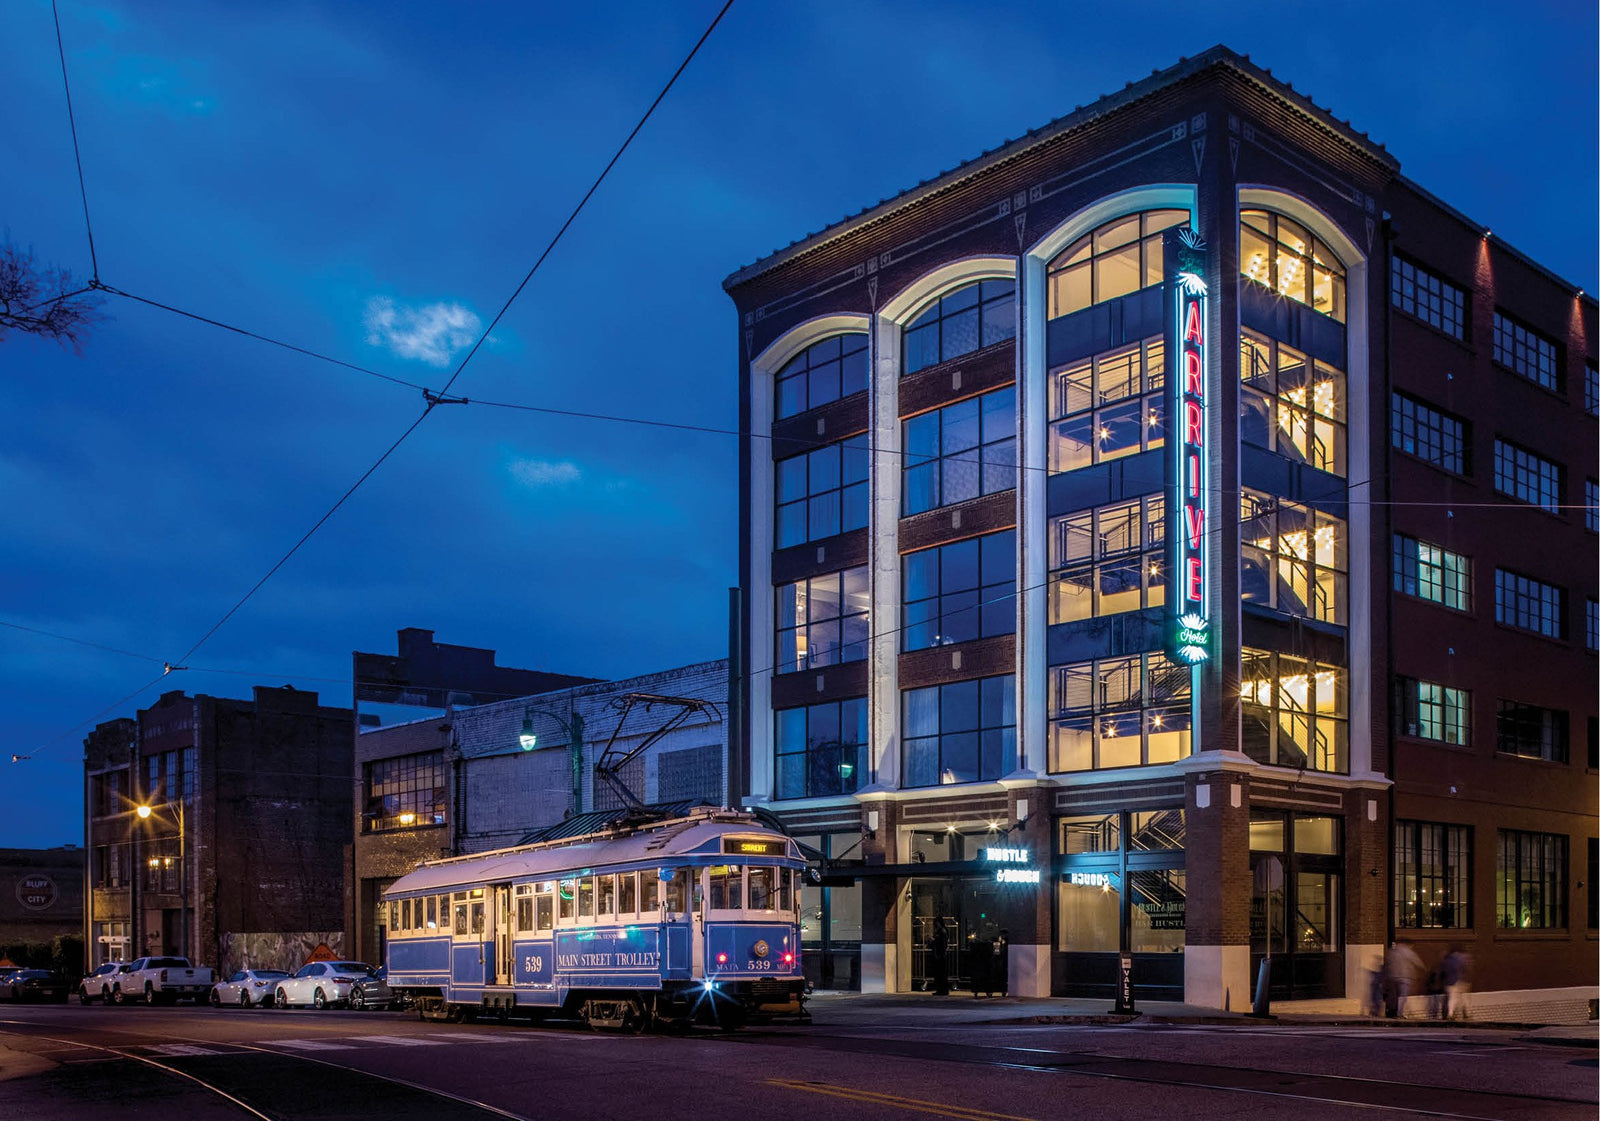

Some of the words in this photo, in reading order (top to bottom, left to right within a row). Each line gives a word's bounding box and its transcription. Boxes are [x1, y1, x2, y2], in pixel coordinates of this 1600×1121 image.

[1184, 301, 1204, 603] ARRIVE
[1180, 628, 1208, 645] Hotel
[986, 847, 1029, 862] HUSTLE
[26, 880, 47, 888] BLUFF
[27, 895, 46, 903] CITY
[525, 955, 542, 973] 539
[558, 954, 579, 967] MAIN
[581, 952, 612, 966] STREET
[614, 951, 656, 966] TROLLEY
[747, 960, 771, 970] 539
[1123, 969, 1131, 1002] VALET
